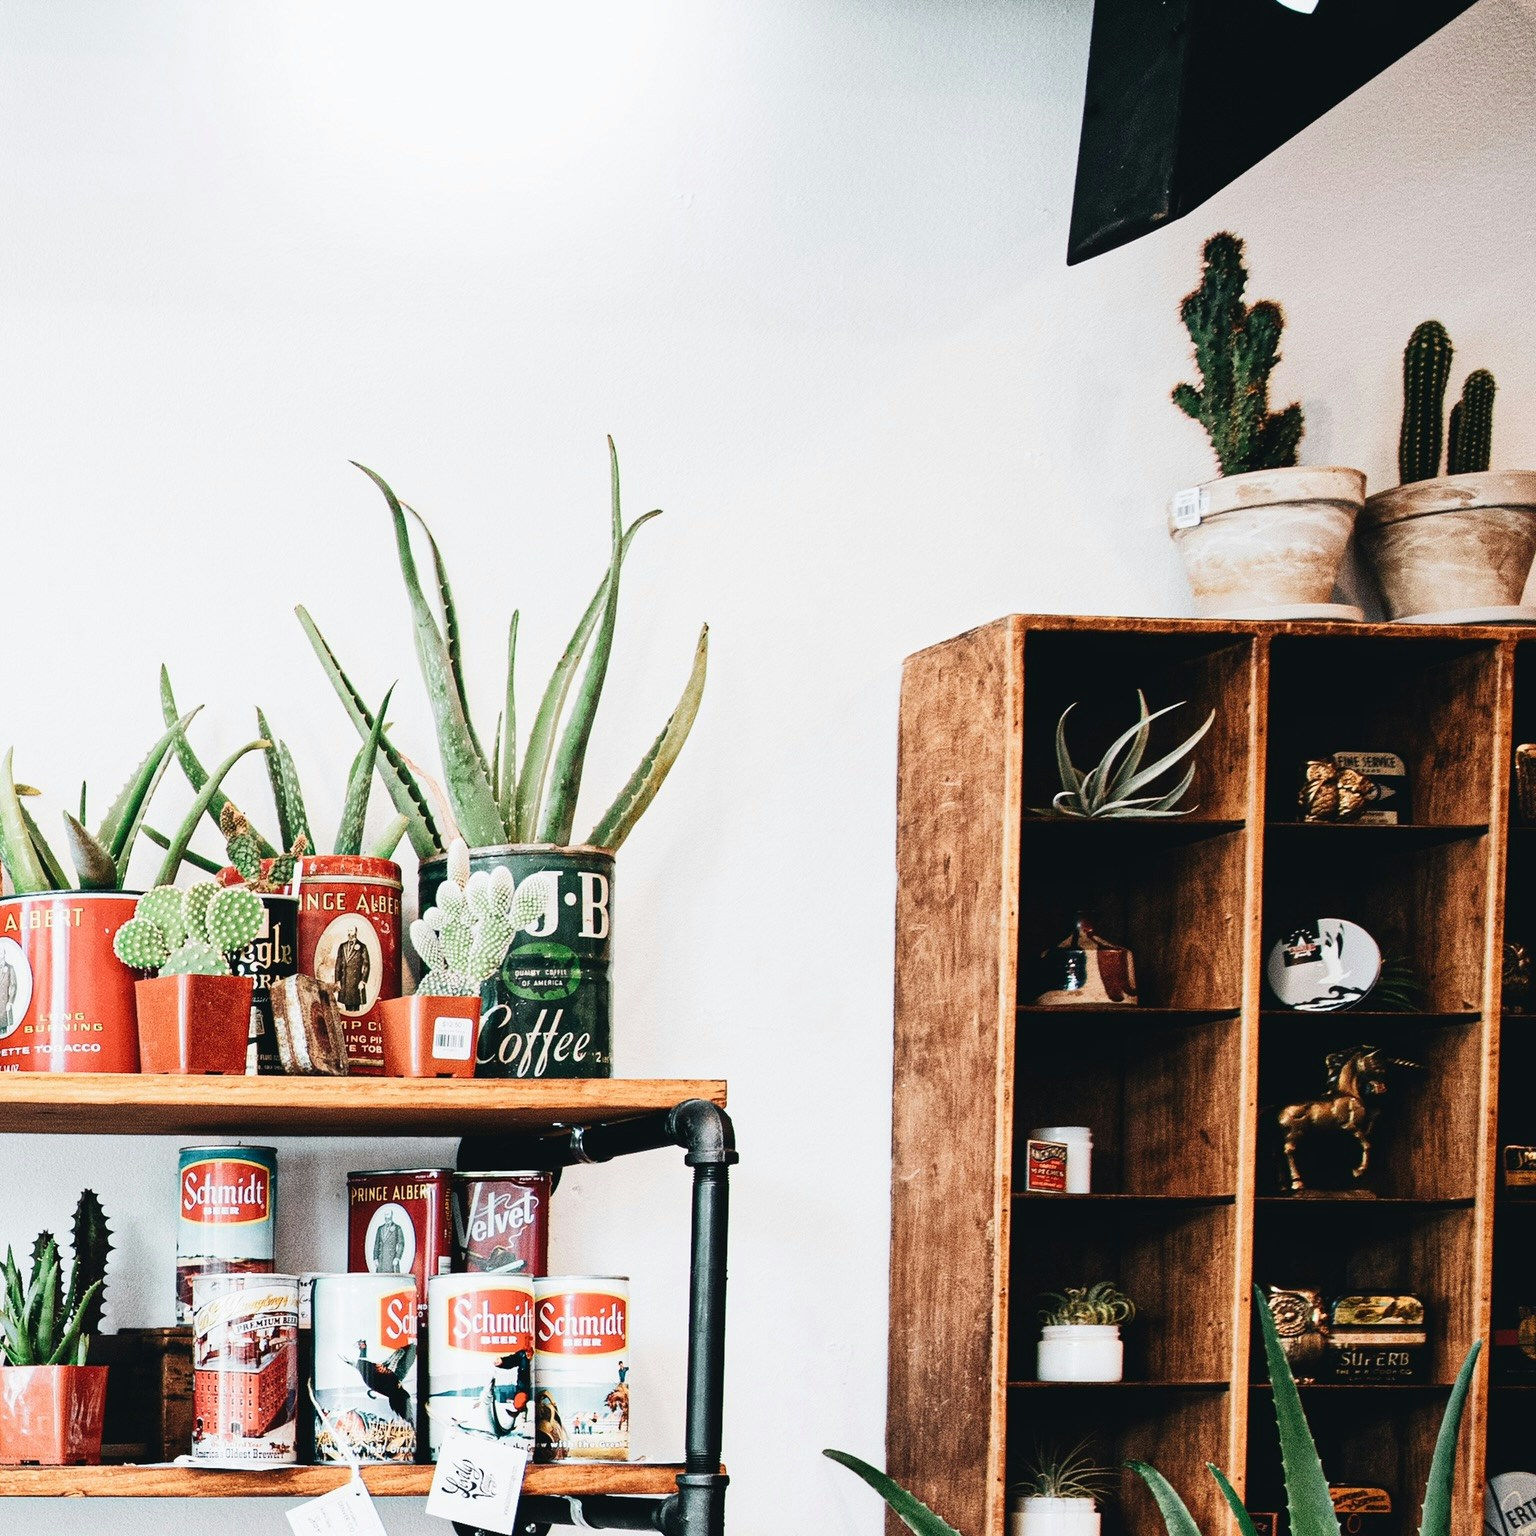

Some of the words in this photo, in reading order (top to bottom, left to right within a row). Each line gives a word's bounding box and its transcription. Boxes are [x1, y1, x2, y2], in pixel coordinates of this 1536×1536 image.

[1338, 755, 1359, 768] FINE
[1363, 756, 1397, 768] SERVICE
[356, 892, 402, 916] ALBER
[4, 907, 85, 933] ALBERT
[39, 1012, 85, 1023] LONG
[24, 1023, 104, 1034] BURNING
[34, 1043, 102, 1053] TOBACCO
[476, 1003, 591, 1078] Coffee
[183, 1171, 265, 1211] Schmidt
[351, 1186, 388, 1205] PRINCE
[203, 1206, 240, 1215] BEER
[453, 1182, 540, 1260] Velvet
[236, 1318, 281, 1332] PREMIUM
[282, 1315, 298, 1325] BEER
[453, 1299, 534, 1339] Schmidt
[539, 1302, 625, 1342] Schmidt
[480, 1336, 518, 1345] BEER
[562, 1338, 603, 1347] BEER
[1340, 1352, 1410, 1366] SUPERB
